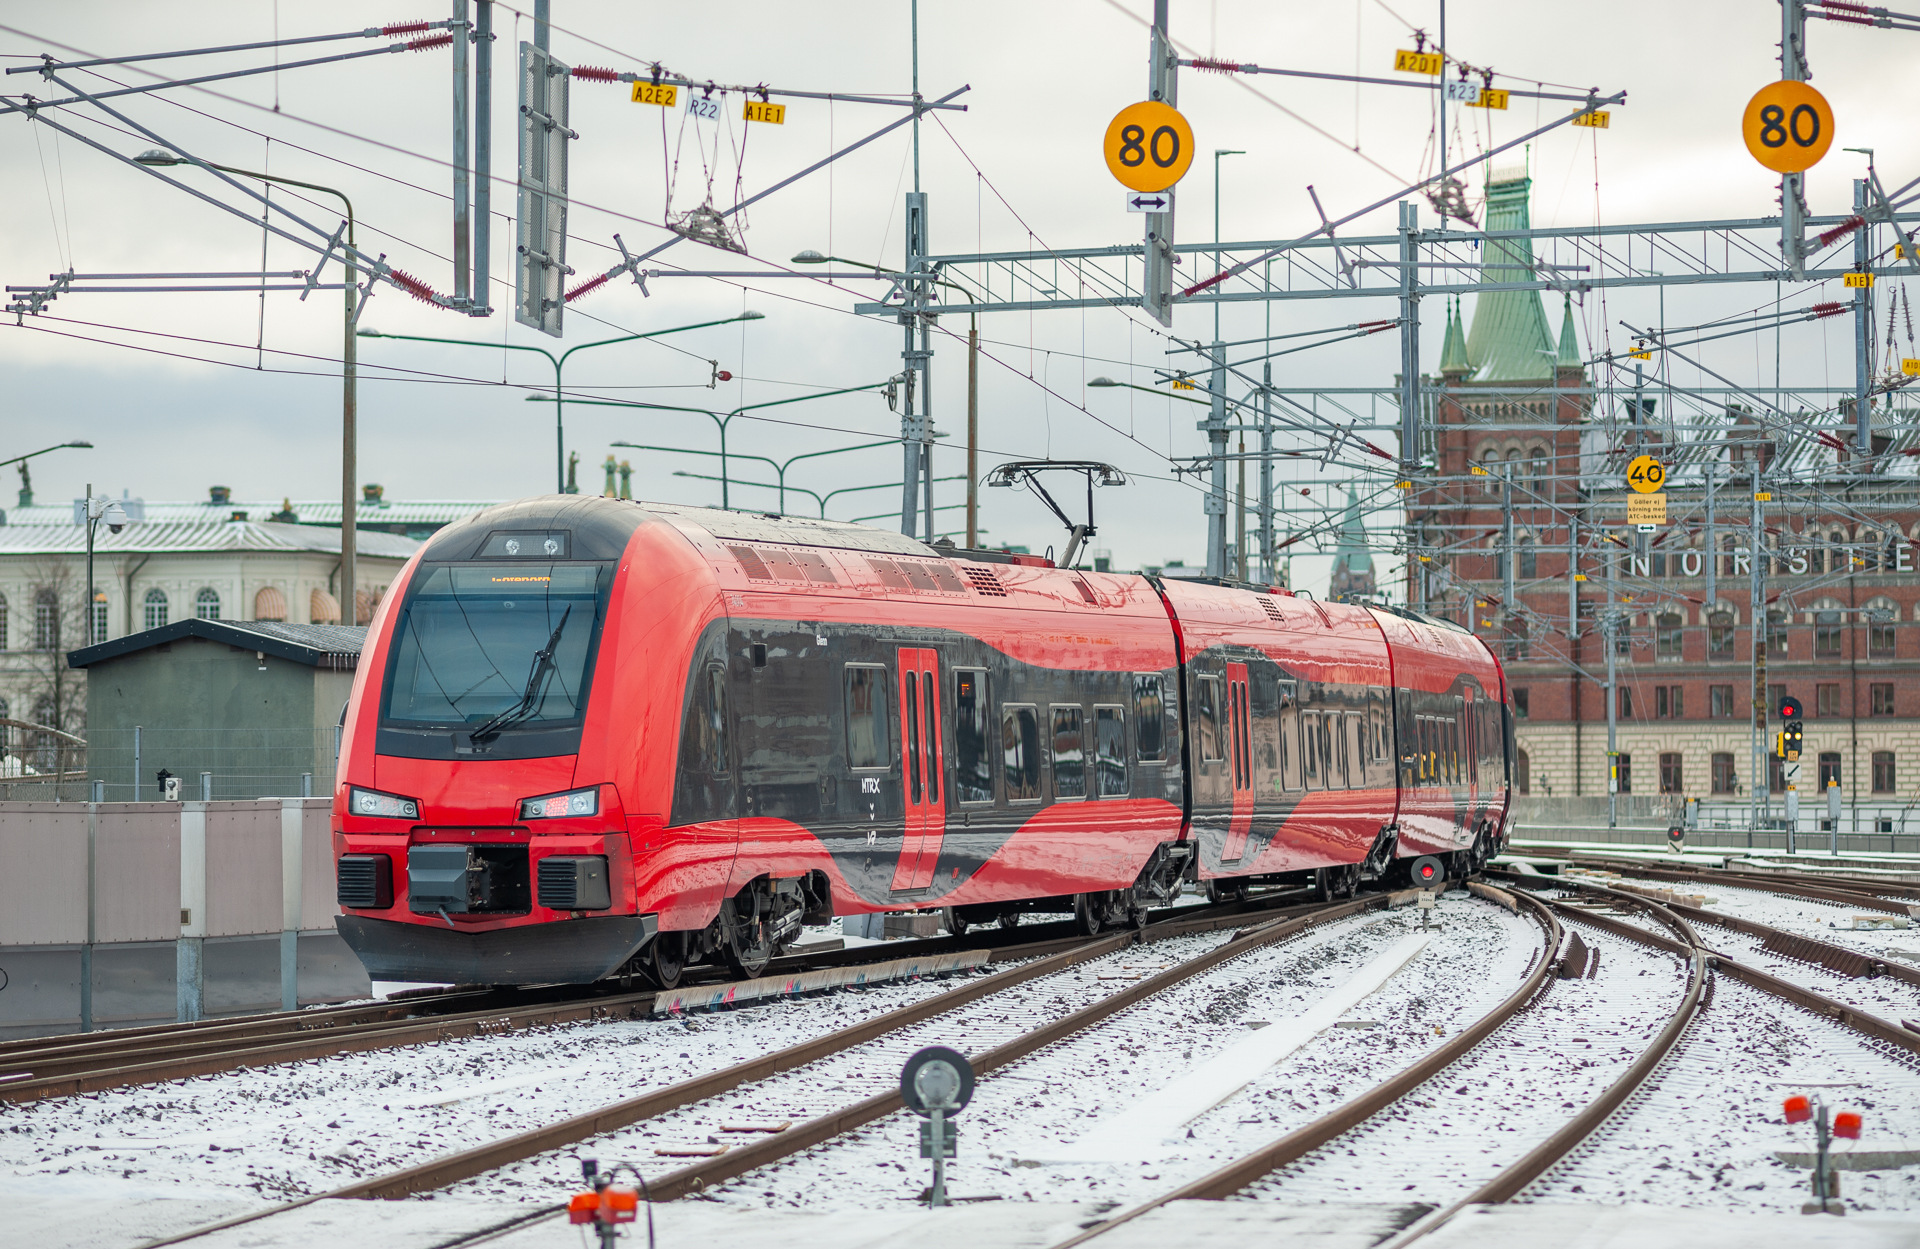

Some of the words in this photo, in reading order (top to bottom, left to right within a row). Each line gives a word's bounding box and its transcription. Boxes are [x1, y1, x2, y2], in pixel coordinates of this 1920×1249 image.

[1397, 54, 1437, 73] A2D1
[634, 86, 674, 105] A2E2
[1448, 84, 1477, 100] R23
[689, 100, 718, 118] R22
[747, 105, 781, 123] A1E1
[1760, 103, 1819, 148] 80
[1119, 124, 1180, 168] 80
[1630, 465, 1662, 483] 40
[861, 777, 881, 794] MTRX
